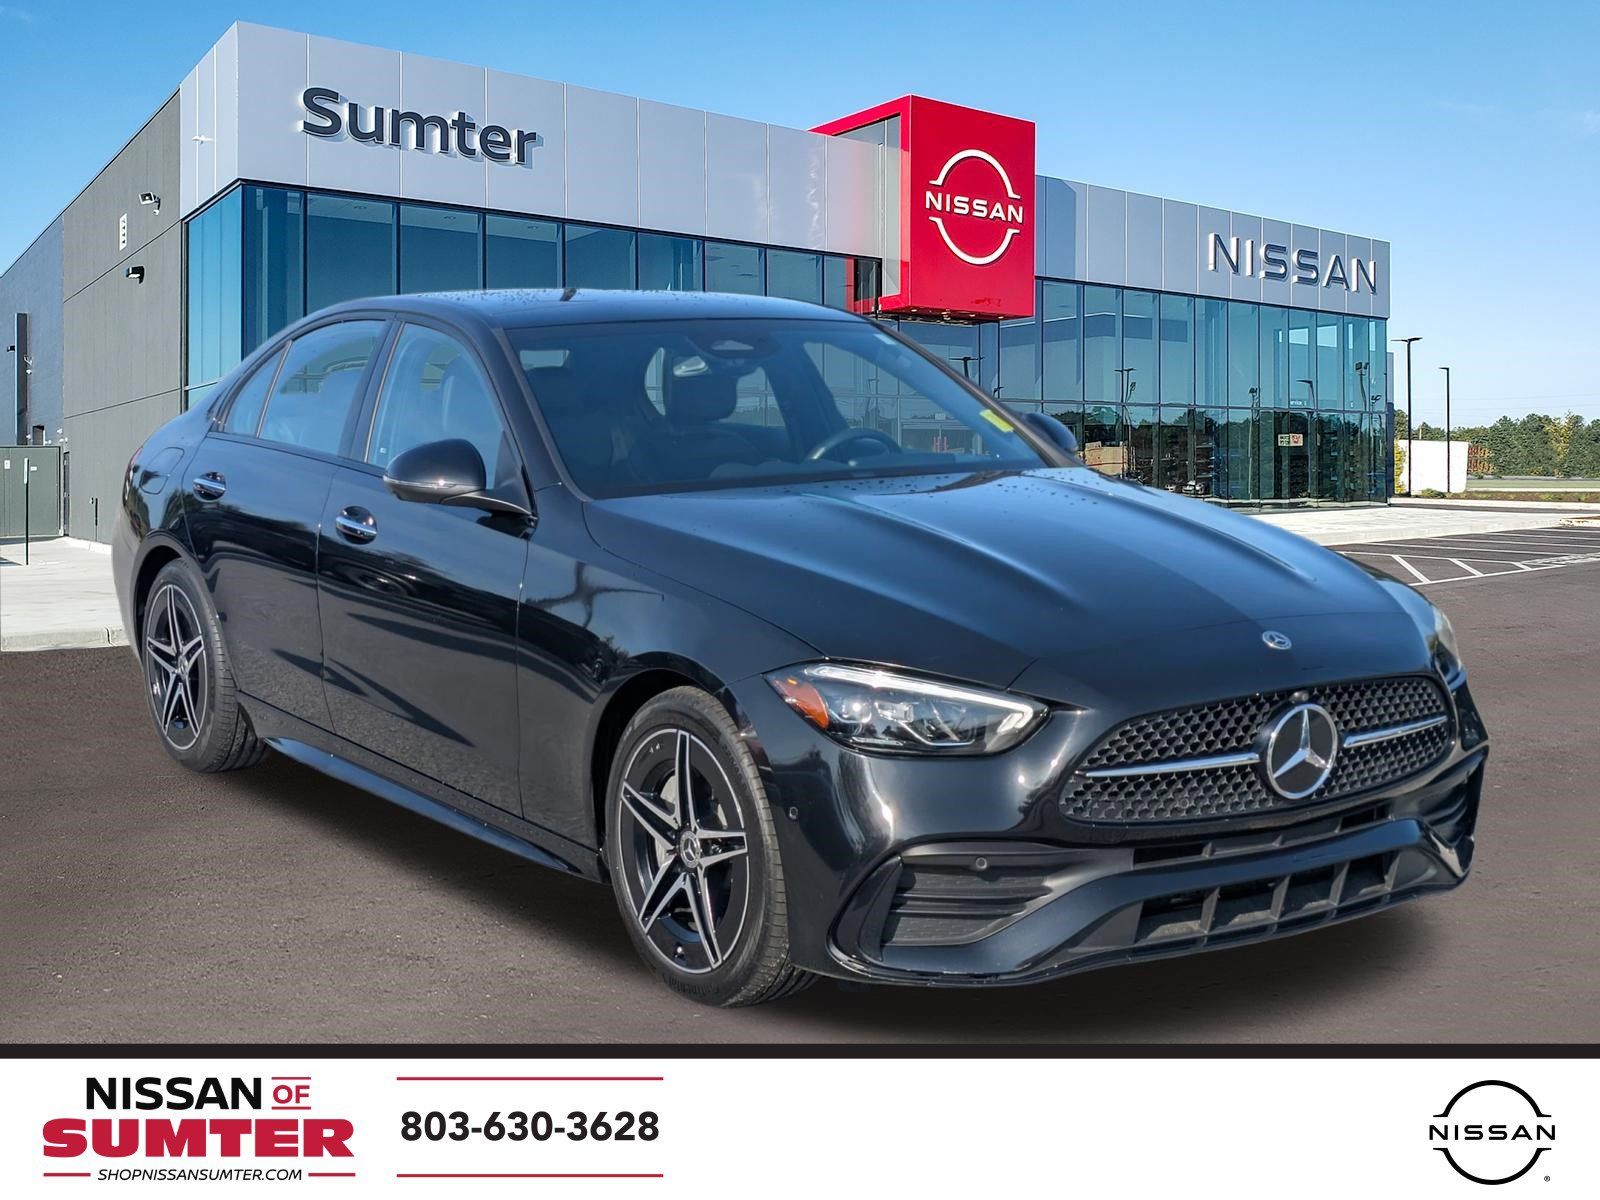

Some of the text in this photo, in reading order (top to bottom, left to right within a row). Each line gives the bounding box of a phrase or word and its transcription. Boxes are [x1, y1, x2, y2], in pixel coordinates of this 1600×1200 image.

[302, 87, 538, 166] Sumter
[925, 190, 1023, 224] NISSAN
[1208, 232, 1377, 295] NISSAN
